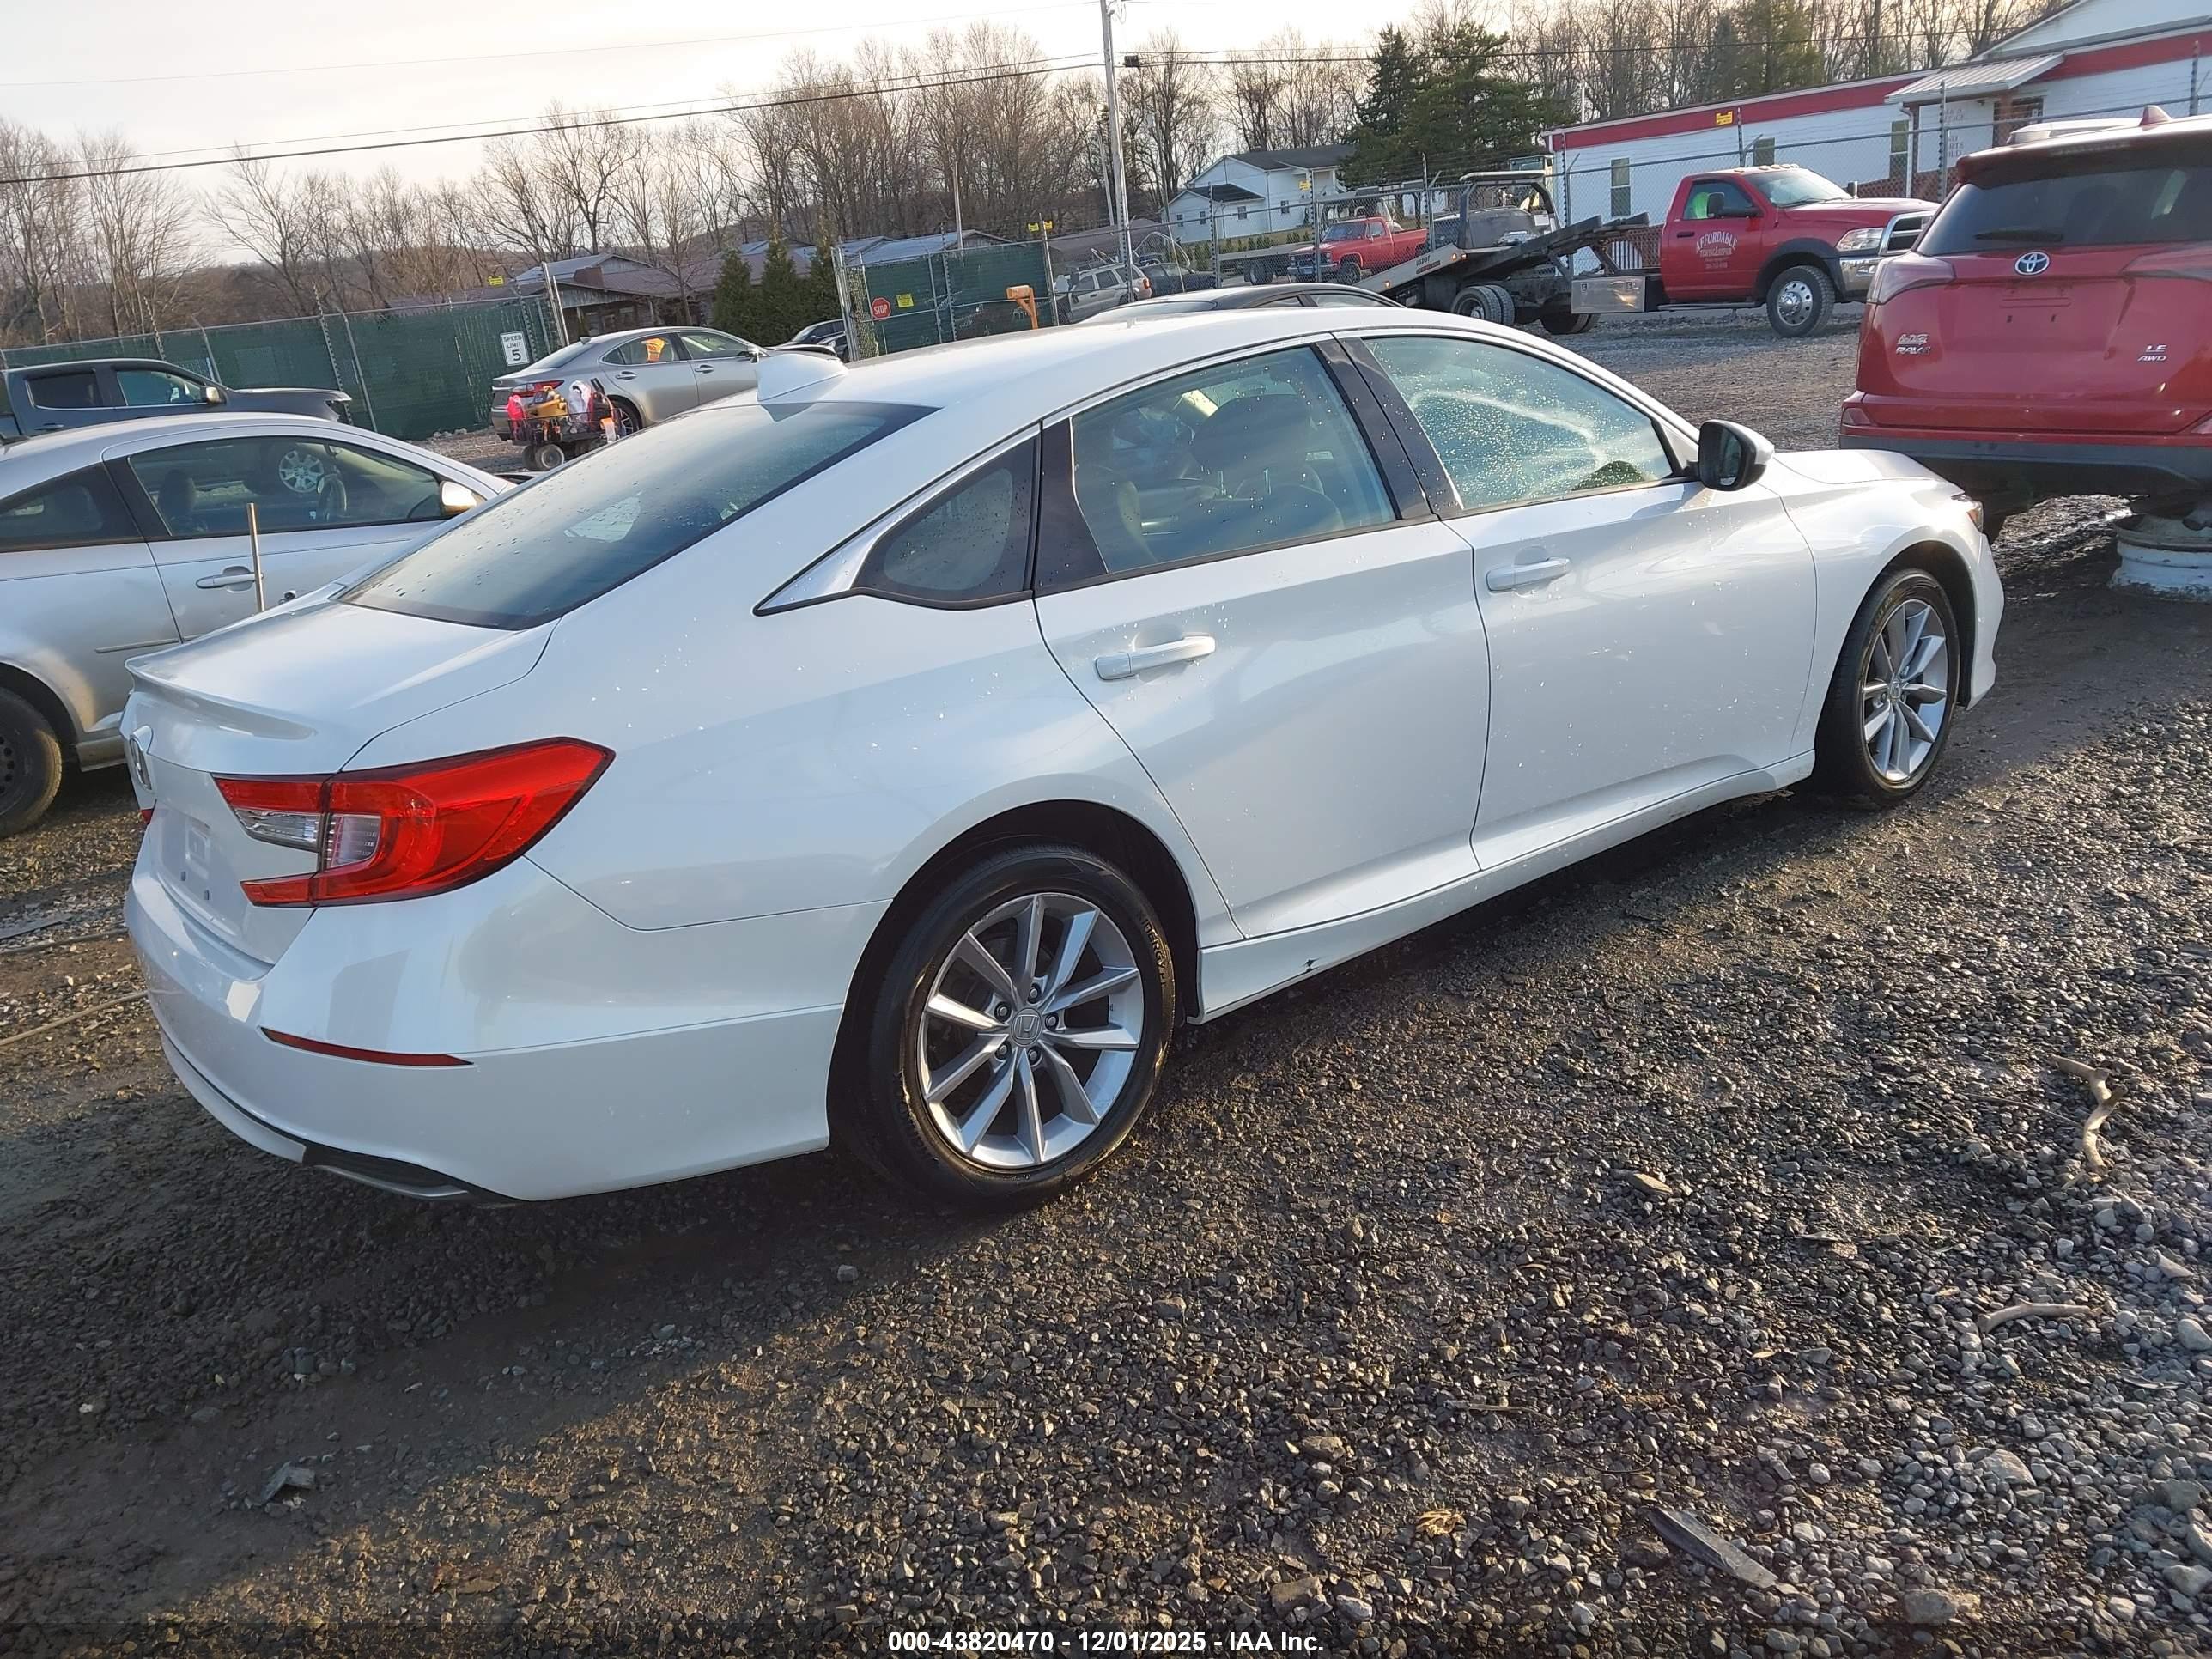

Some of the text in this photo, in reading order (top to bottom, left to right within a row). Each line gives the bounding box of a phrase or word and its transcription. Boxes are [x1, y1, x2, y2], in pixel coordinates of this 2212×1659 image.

[1696, 231, 1738, 255] AFFORDABLE
[873, 304, 888, 315] STOP
[1896, 346, 1931, 355] RAV4
[2145, 344, 2168, 353] LE
[511, 349, 522, 362] 5
